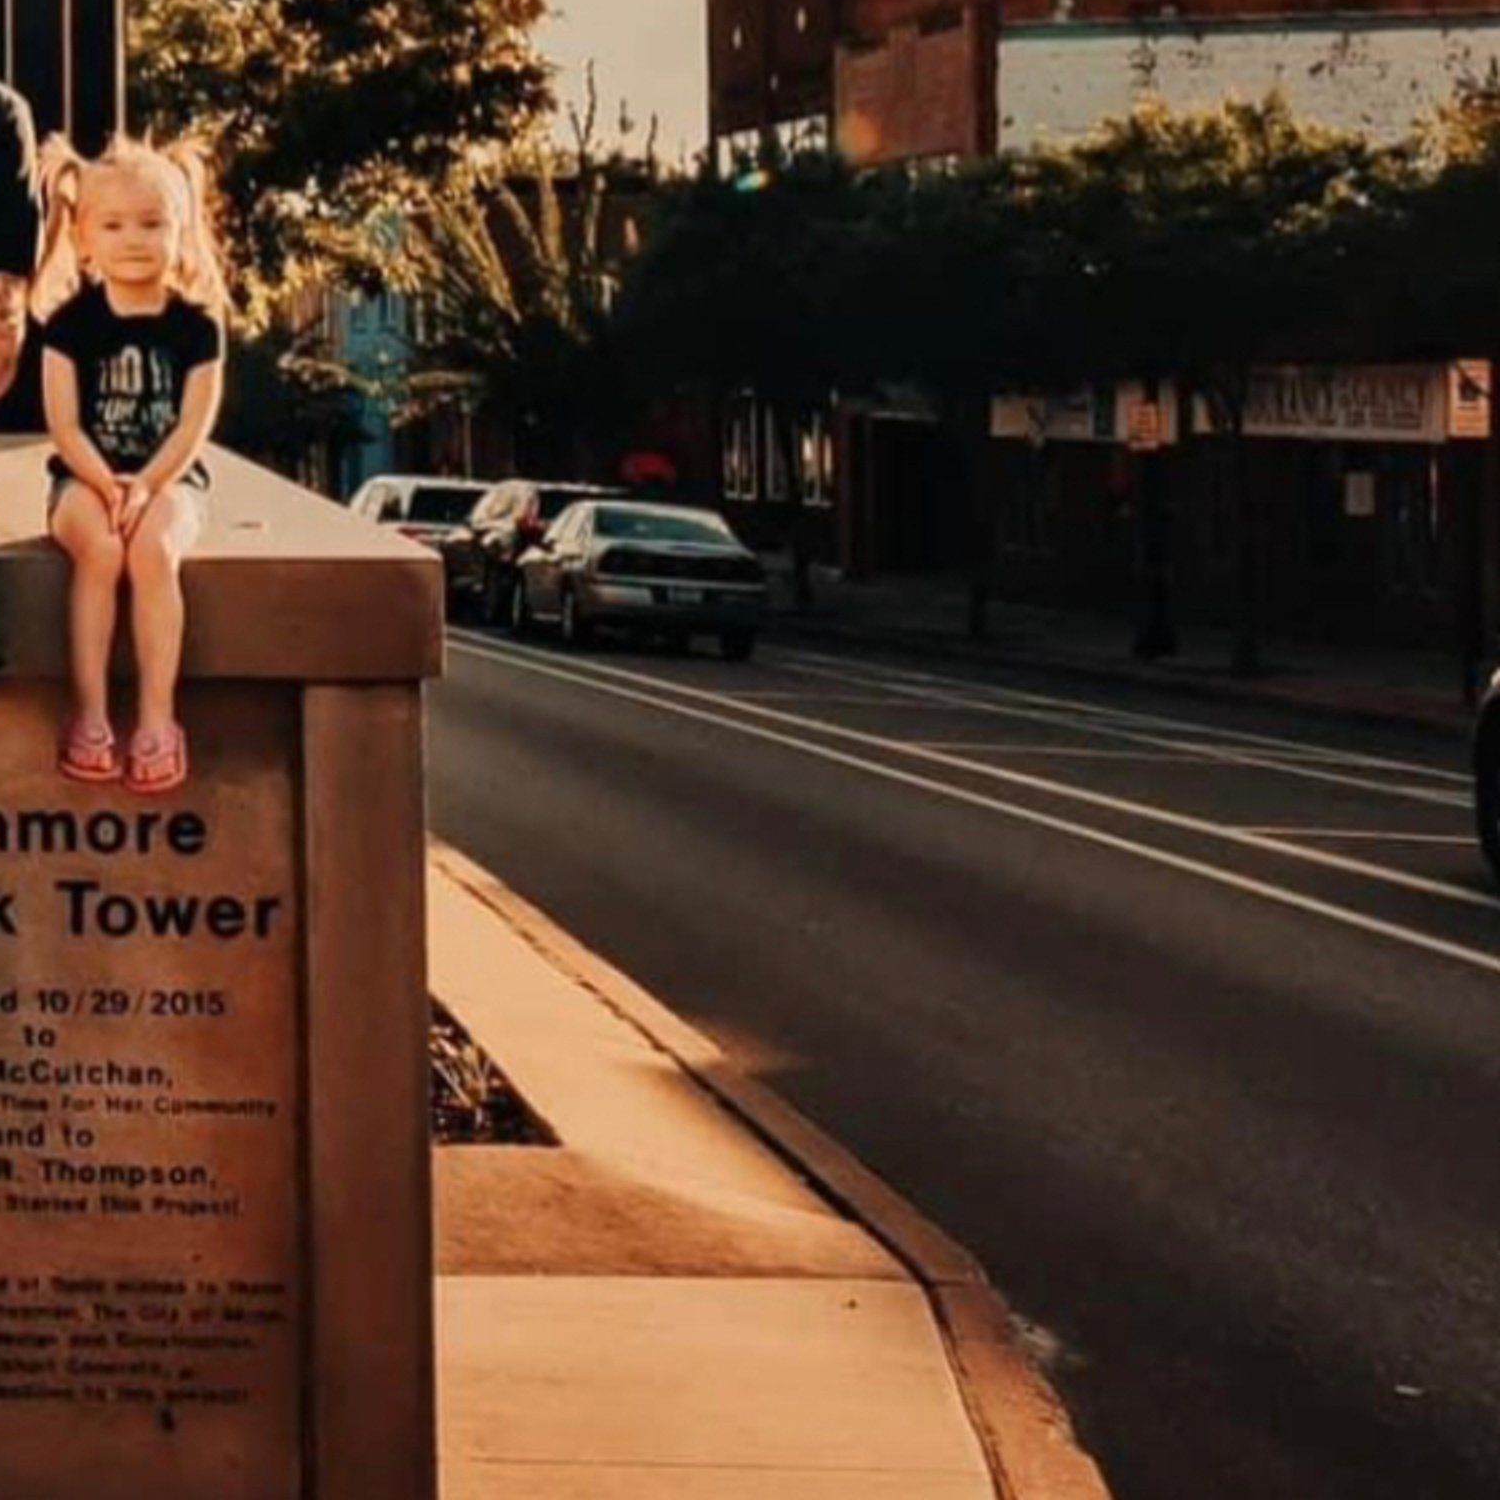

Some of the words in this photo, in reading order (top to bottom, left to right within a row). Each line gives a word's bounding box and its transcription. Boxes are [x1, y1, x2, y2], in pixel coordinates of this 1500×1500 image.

[55, 880, 281, 938] Tower
[37, 990, 226, 1017] 10/29/2015
[23, 1024, 56, 1049] to
[62, 1123, 95, 1148] to
[41, 1157, 217, 1191] Thompson,
